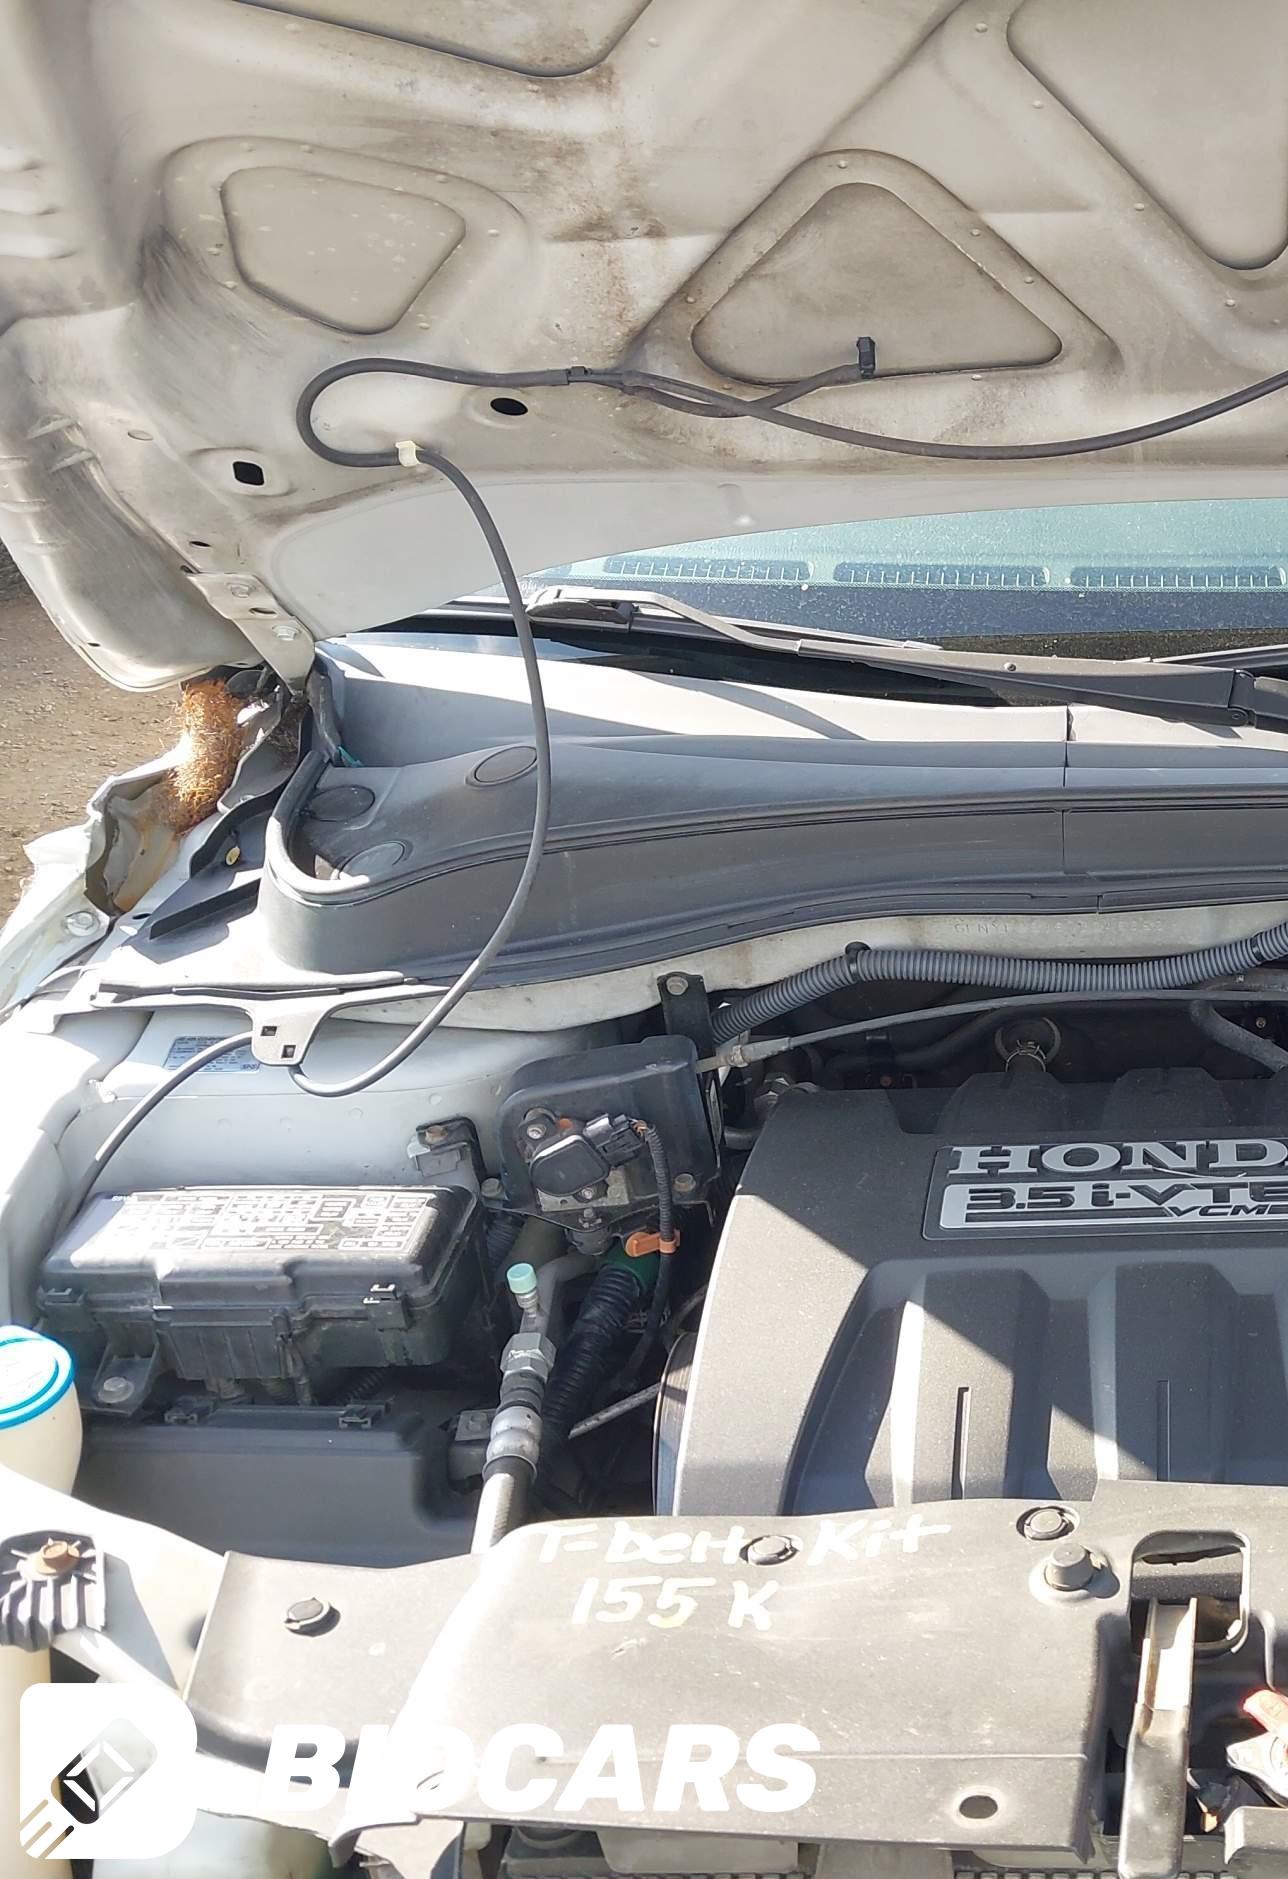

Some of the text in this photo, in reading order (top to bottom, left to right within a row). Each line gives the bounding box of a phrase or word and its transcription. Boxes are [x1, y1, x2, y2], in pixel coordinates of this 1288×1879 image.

[965, 1186, 1076, 1211] 3.5
[1167, 1203, 1271, 1218] VCM
[809, 1514, 951, 1565] Kit
[571, 1576, 780, 1631] 155 K
